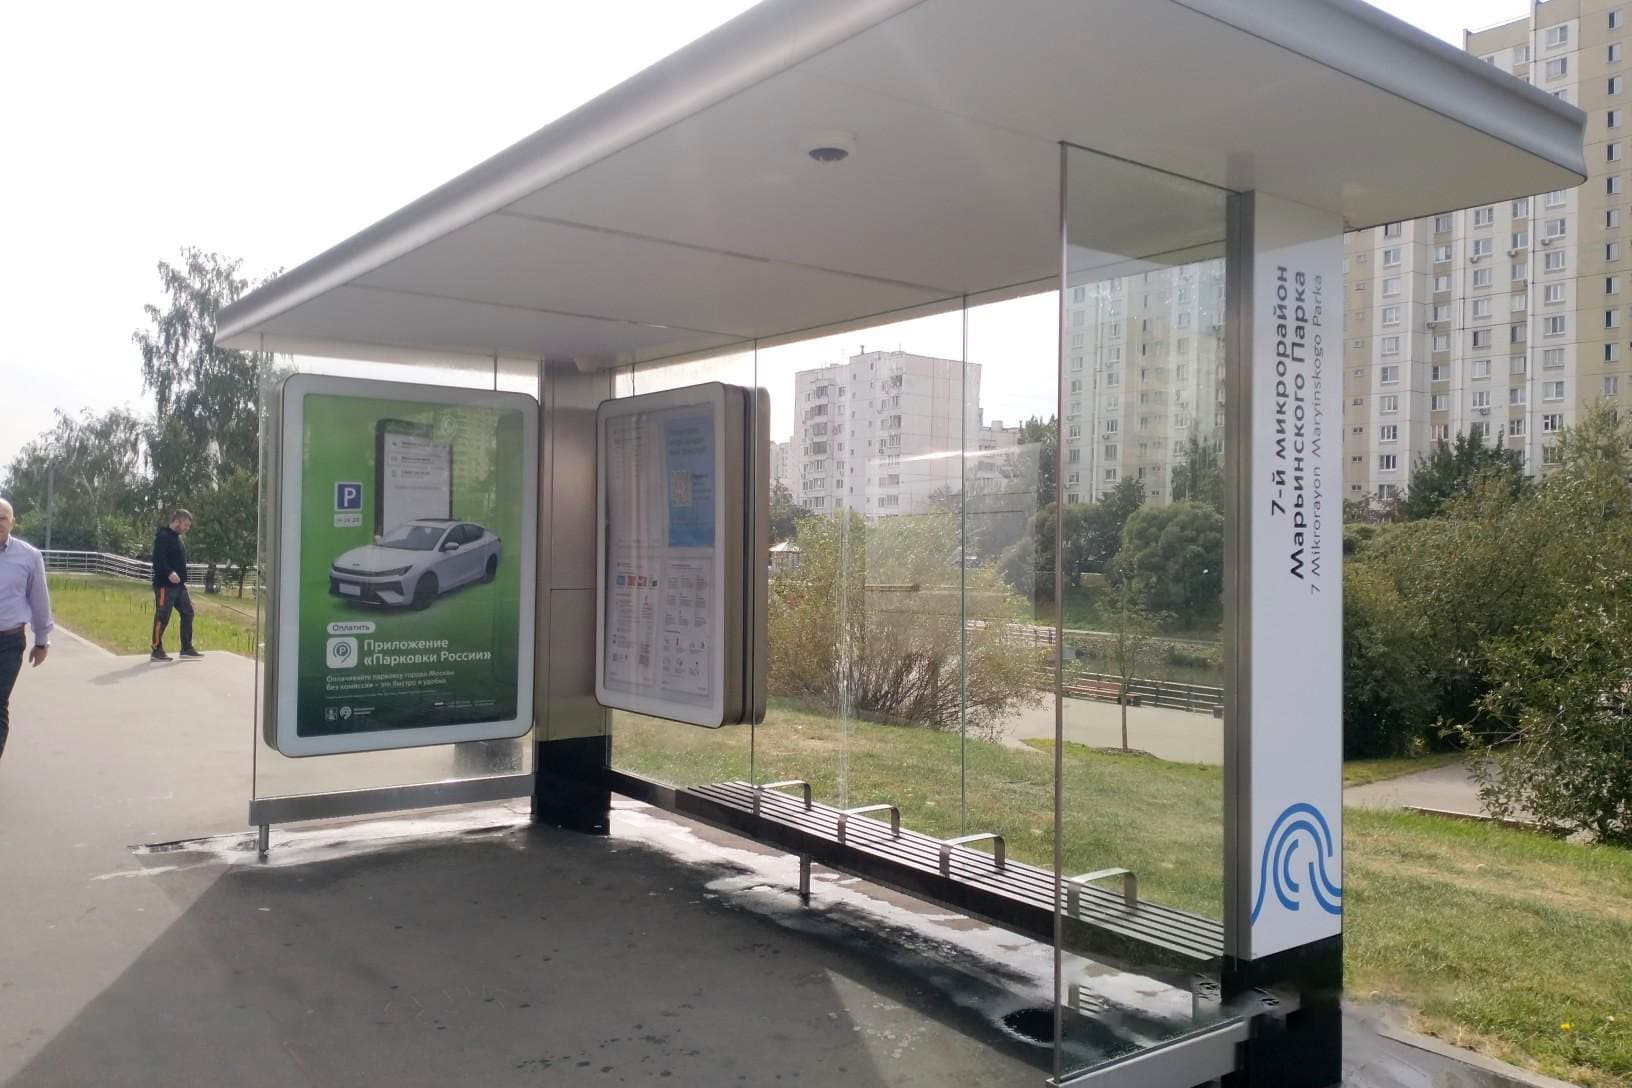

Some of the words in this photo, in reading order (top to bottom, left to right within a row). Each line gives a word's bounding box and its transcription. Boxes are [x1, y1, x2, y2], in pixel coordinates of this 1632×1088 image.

[1291, 270, 1307, 363] Парка
[1312, 273, 1322, 327] Parka
[1273, 264, 1290, 460] микрорайон
[1311, 333, 1323, 457] Maryinskogo
[343, 487, 357, 508] P
[1271, 468, 1288, 516] 7-й
[1290, 372, 1307, 579] Марьинского
[1310, 465, 1323, 576] Mikrorayon
[1311, 583, 1321, 594] 7
[332, 623, 370, 633] Оплатить
[364, 638, 449, 652] Приложение
[364, 653, 437, 667] «Парковки
[440, 649, 492, 662] России»
